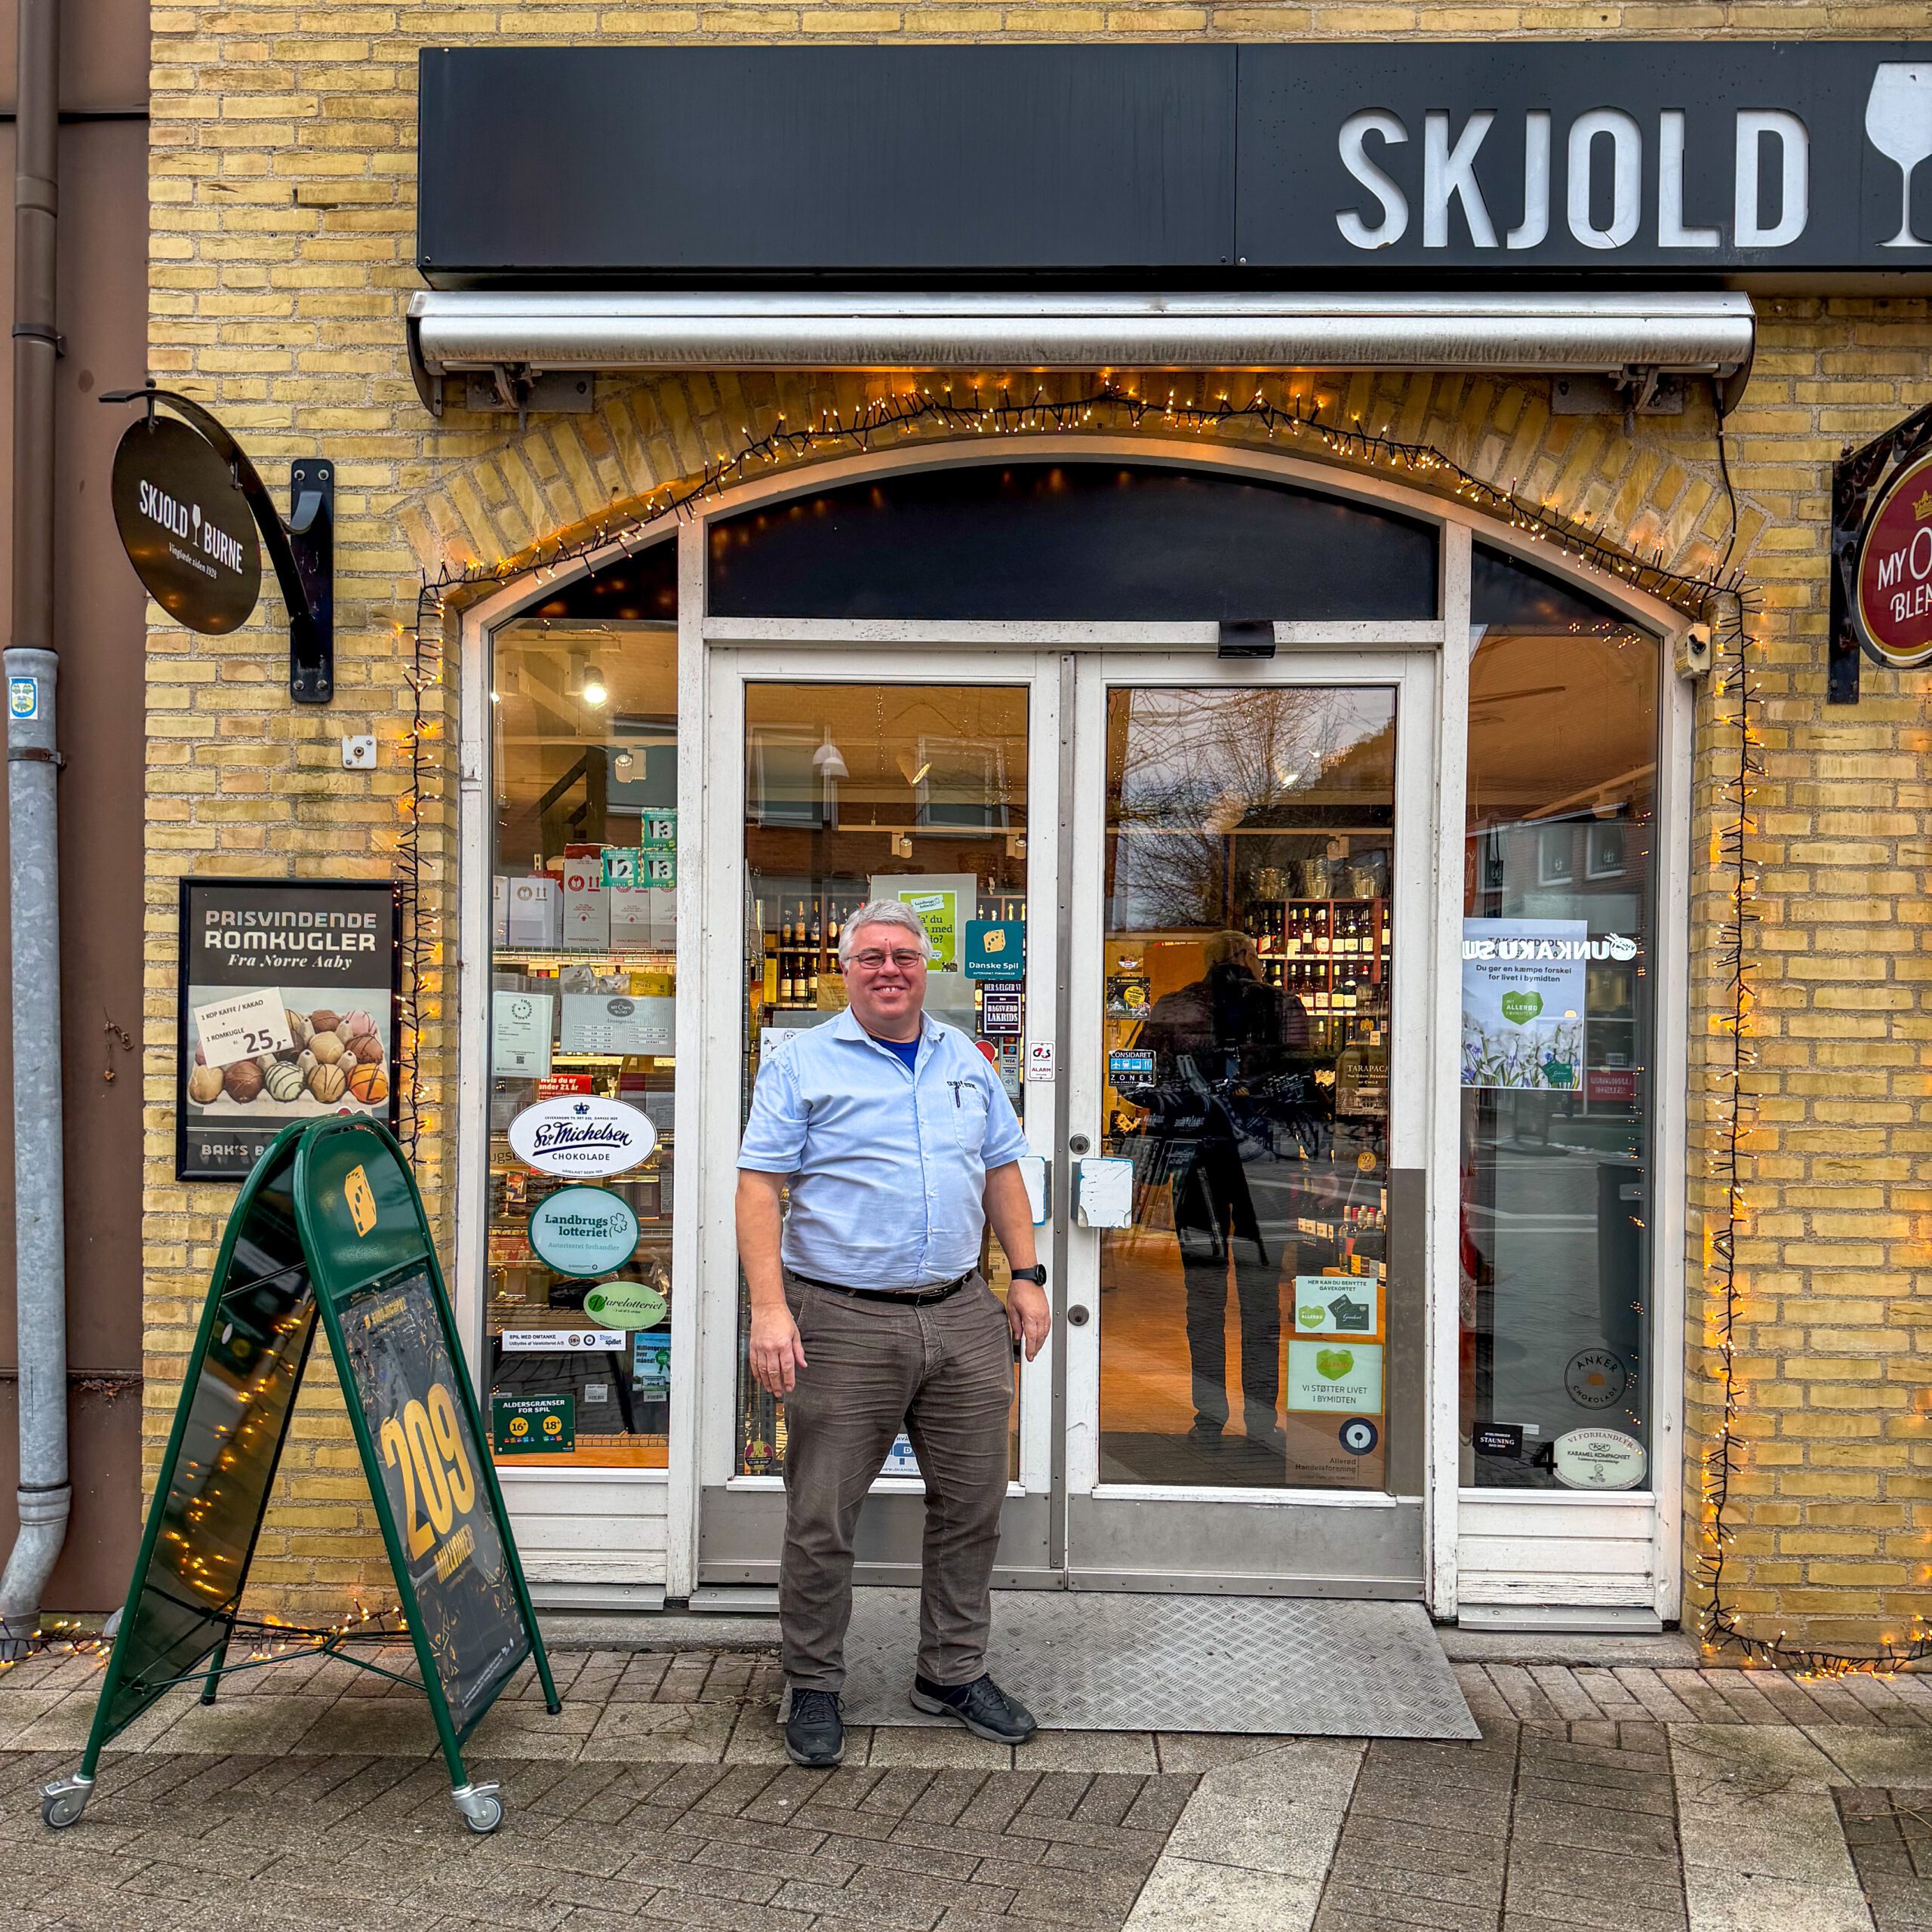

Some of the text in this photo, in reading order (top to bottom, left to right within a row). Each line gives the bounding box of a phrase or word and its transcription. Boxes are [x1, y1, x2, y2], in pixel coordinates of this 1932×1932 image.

[1335, 106, 1810, 250] SKJOLD
[140, 480, 243, 574] SKJOLD BURNE
[192, 558, 205, 572] siden
[1878, 548, 1907, 591] MY
[652, 820, 673, 839] 13
[611, 859, 634, 878] 12
[652, 860, 673, 879] 13
[205, 910, 377, 928] PRISVINDENDE
[930, 915, 943, 924] du
[931, 924, 952, 933] med
[205, 931, 376, 952] ROMKUGLER
[227, 954, 256, 967] Fra
[312, 955, 352, 971] Aaby
[219, 1007, 236, 1016] KAFFE
[242, 999, 263, 1009] KAKAO
[987, 1014, 1018, 1022] LAKRIDS
[211, 1028, 245, 1041] ROMKUGLE
[552, 1121, 632, 1146] Michelsen
[545, 1214, 608, 1228] Landbrugs
[558, 1226, 608, 1237] lotteriet
[589, 1294, 663, 1311] Varelotteriet
[1577, 1355, 1618, 1373] ANKER
[1312, 1385, 1345, 1393] STØTTER
[1573, 1385, 1618, 1403] CHOKOLADE
[503, 1400, 565, 1408] ALDERSGRÆNSER
[1317, 1395, 1356, 1404] BYMIDTEN
[1480, 1437, 1515, 1445] STAUNING
[1579, 1432, 1634, 1448] FORHANDLER
[380, 1382, 476, 1563] 209
[1295, 1464, 1356, 1473] Handelsforening
